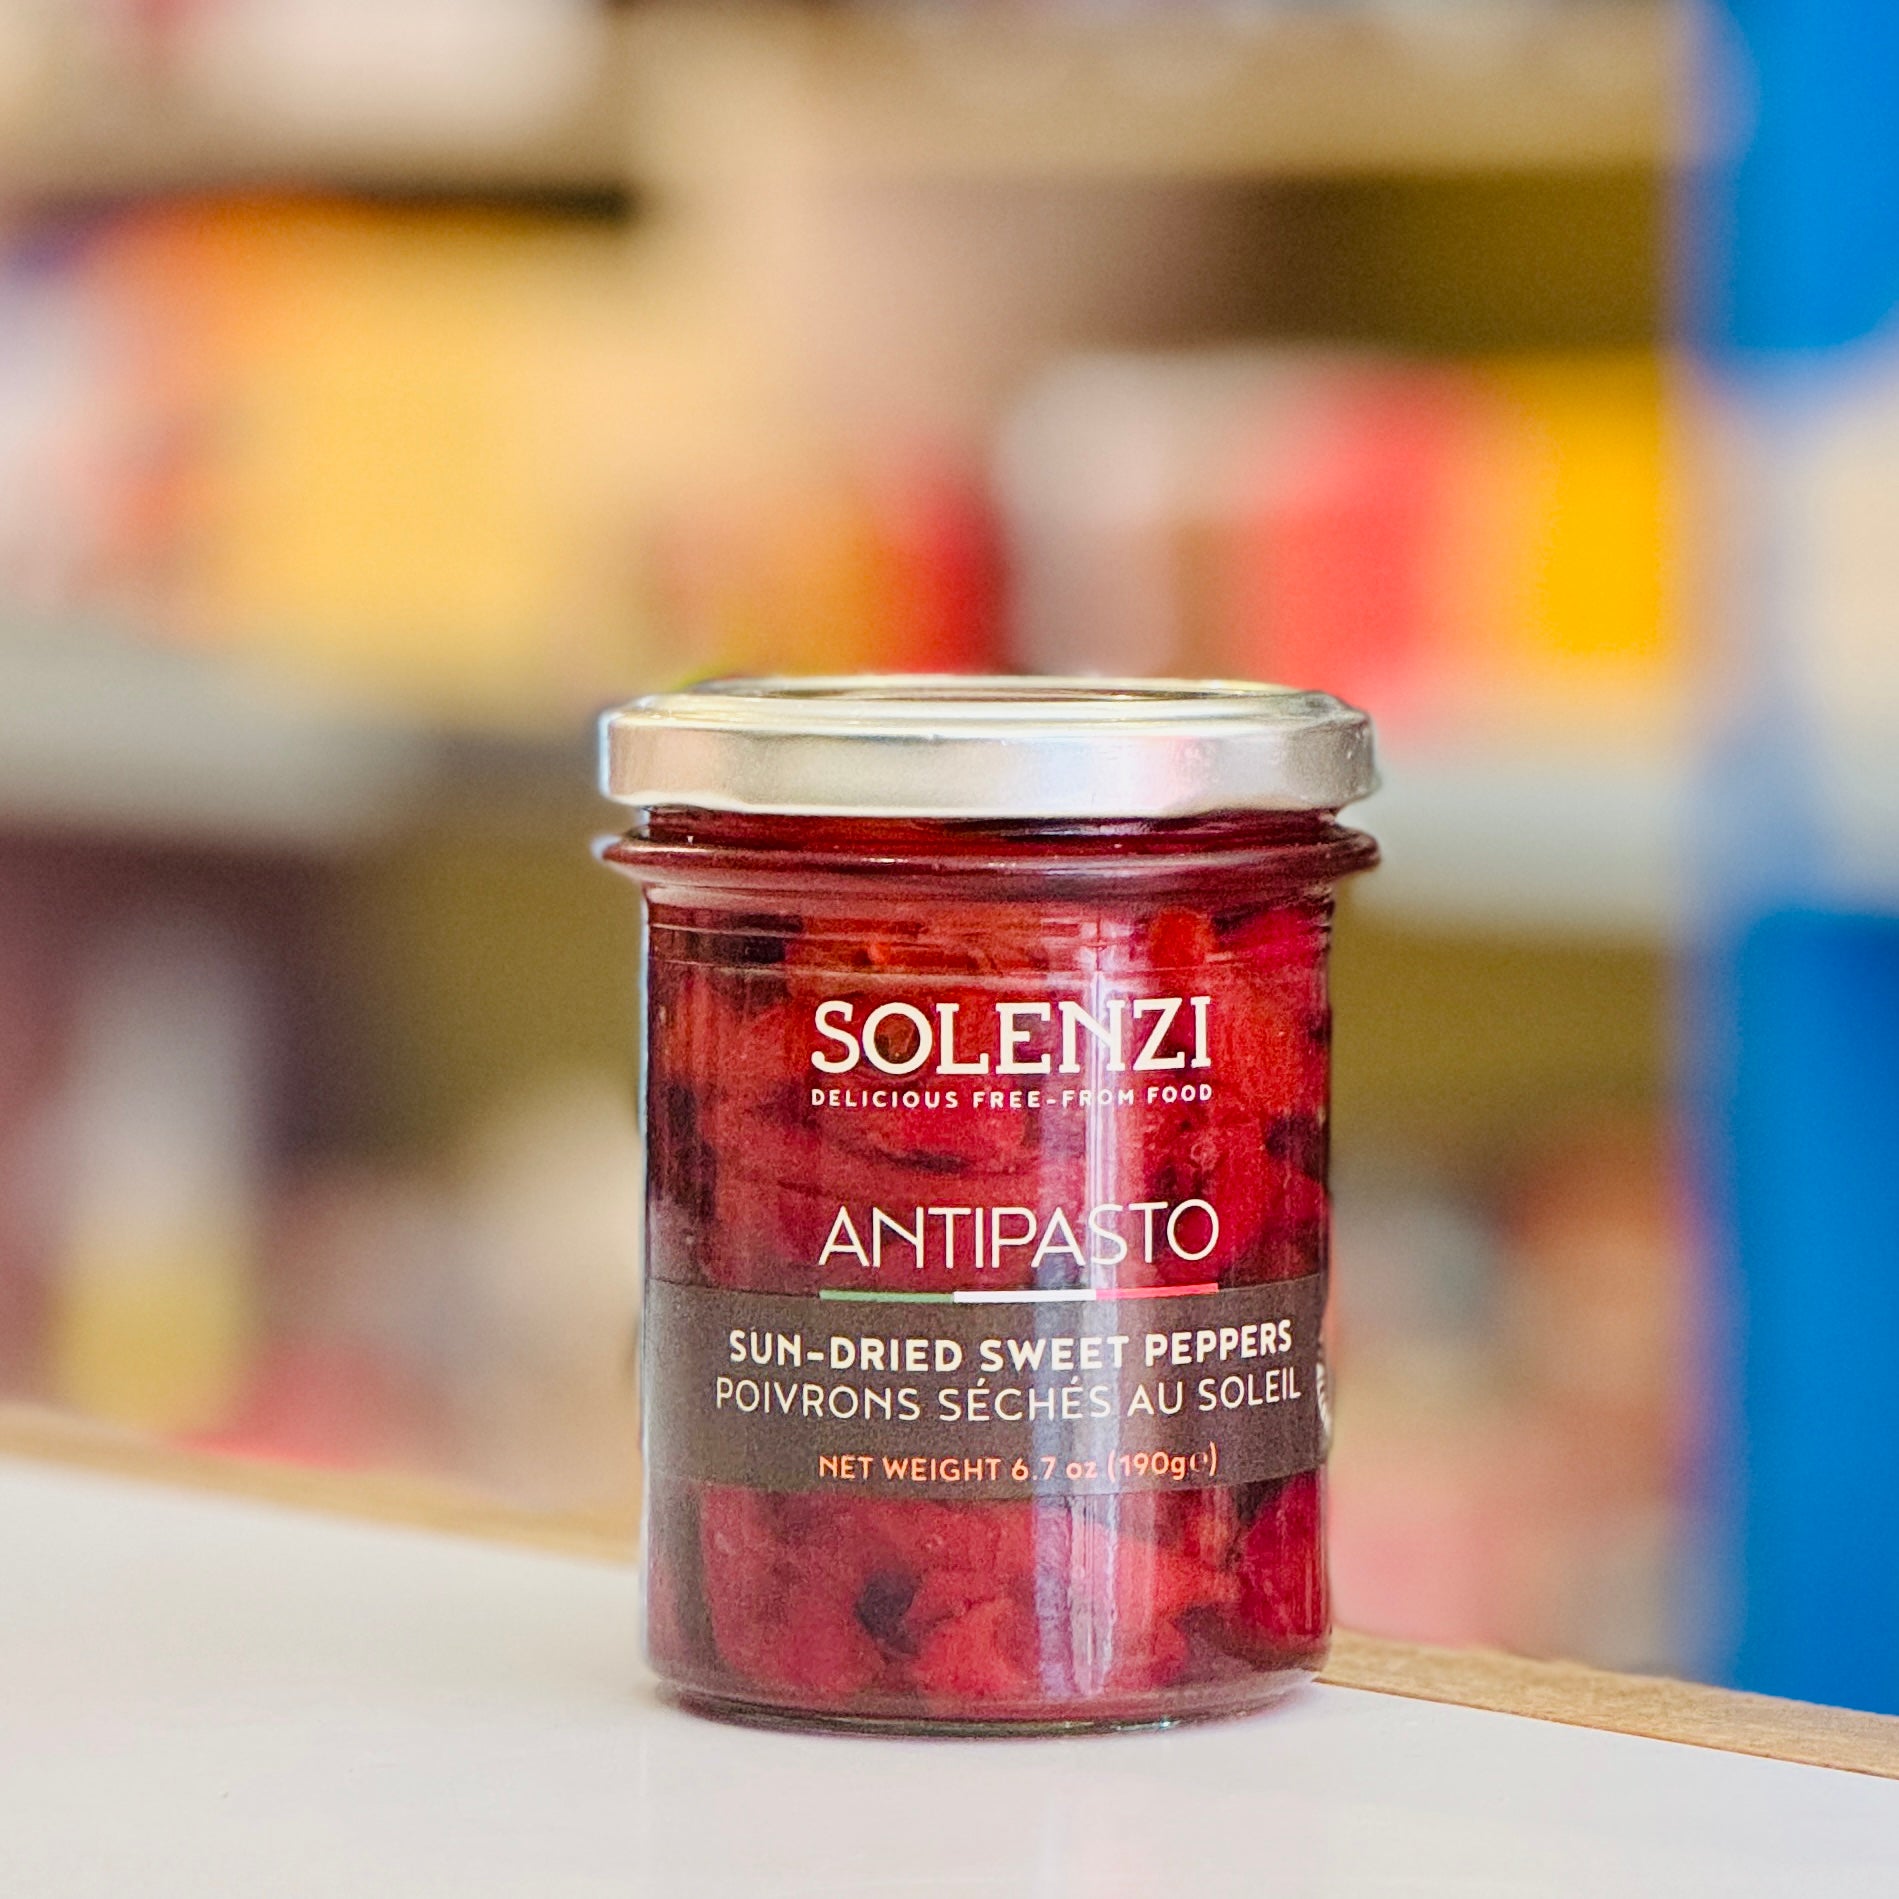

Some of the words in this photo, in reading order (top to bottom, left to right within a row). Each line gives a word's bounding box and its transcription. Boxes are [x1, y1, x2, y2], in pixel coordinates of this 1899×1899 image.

[811, 996, 1212, 1075] SOLENZI
[811, 1088, 958, 1109] DELICIOUS
[973, 1089, 1135, 1109] FREE-FROM
[1147, 1083, 1213, 1103] FOOD
[818, 1198, 1219, 1269] ANTIPASTO
[729, 1329, 963, 1373] SUN-DRIED
[981, 1334, 1129, 1373] SWEET
[1145, 1319, 1293, 1367] PEPPERS
[716, 1375, 920, 1421] POIVRONS
[938, 1375, 1112, 1422] SÉCHÉS
[1127, 1381, 1184, 1417] AU
[1198, 1366, 1301, 1413] SOLEIL
[818, 1454, 873, 1481] NET
[881, 1455, 1001, 1482] WEIGHT
[1011, 1455, 1057, 1481] 6.7
[1066, 1461, 1097, 1480] oz
